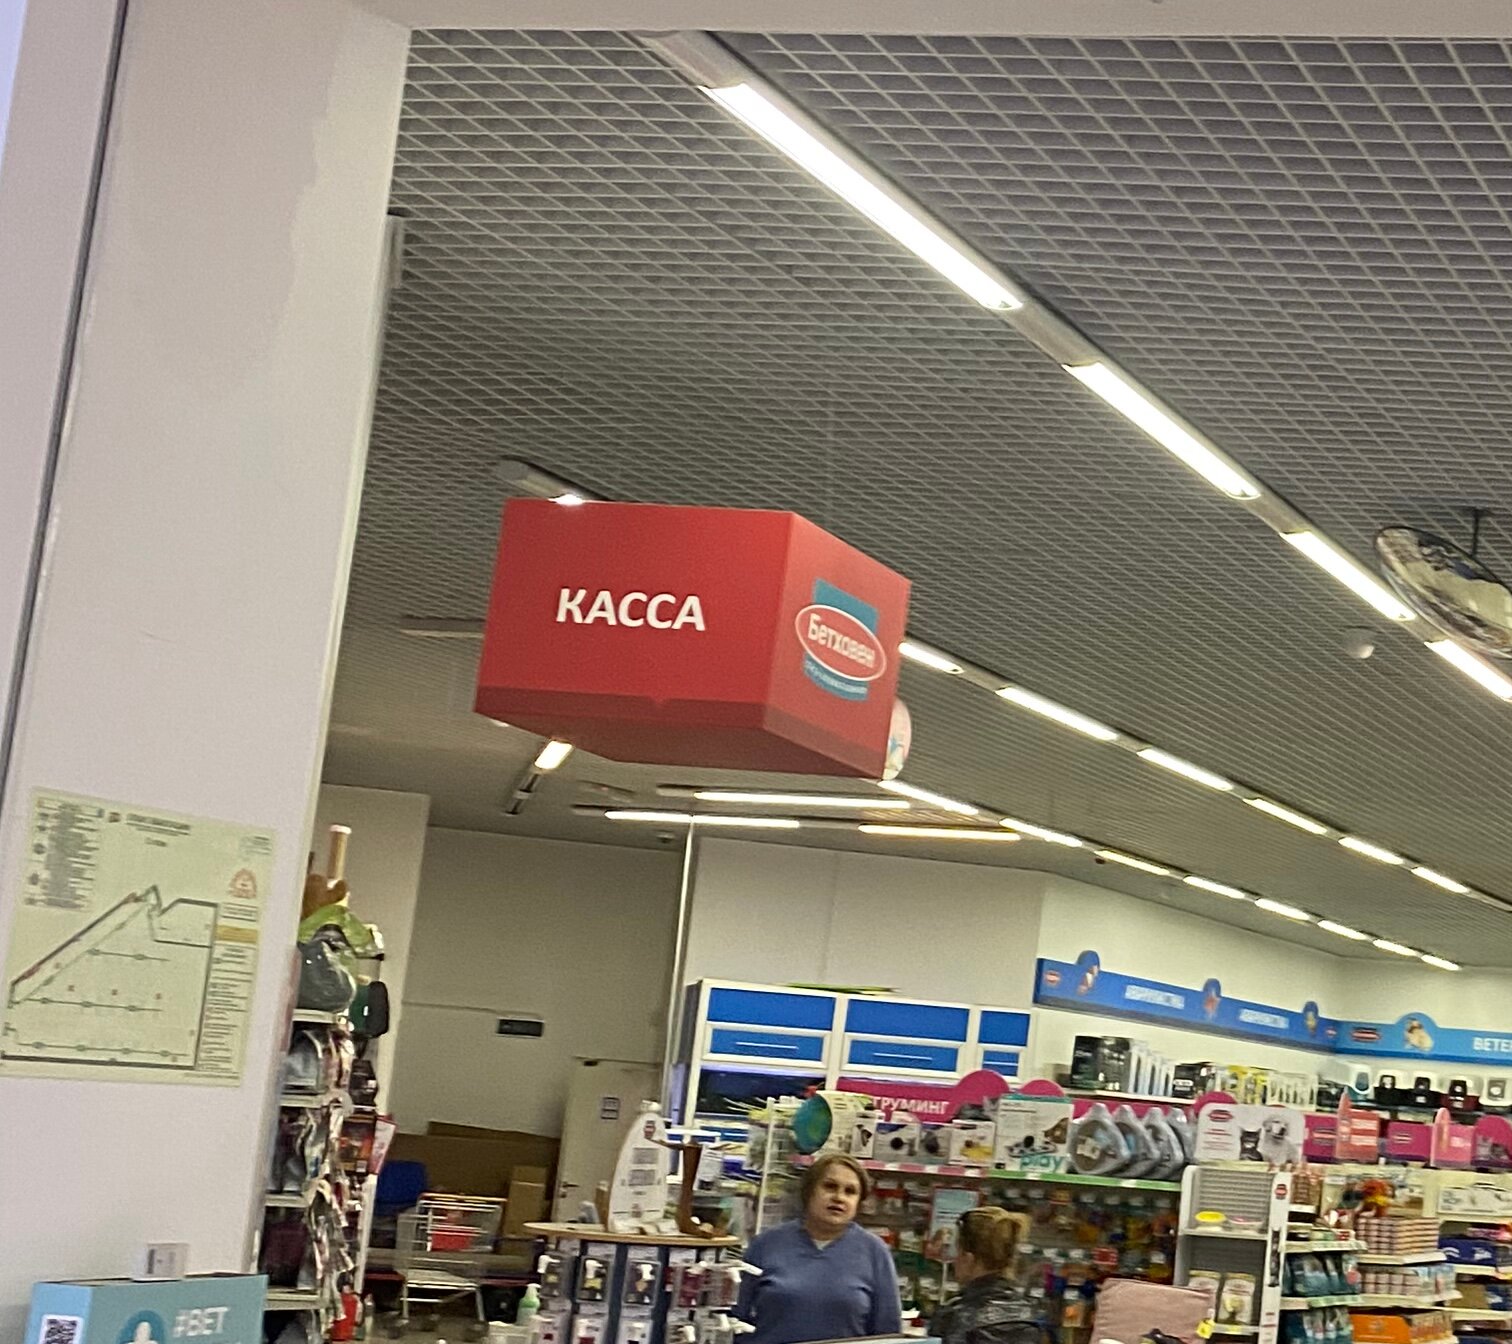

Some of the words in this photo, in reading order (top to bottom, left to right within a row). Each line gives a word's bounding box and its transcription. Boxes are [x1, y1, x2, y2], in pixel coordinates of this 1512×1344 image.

[556, 587, 706, 631] КАССА
[808, 613, 875, 667] Бетховен
[173, 1306, 230, 1338] #ВЕТ
